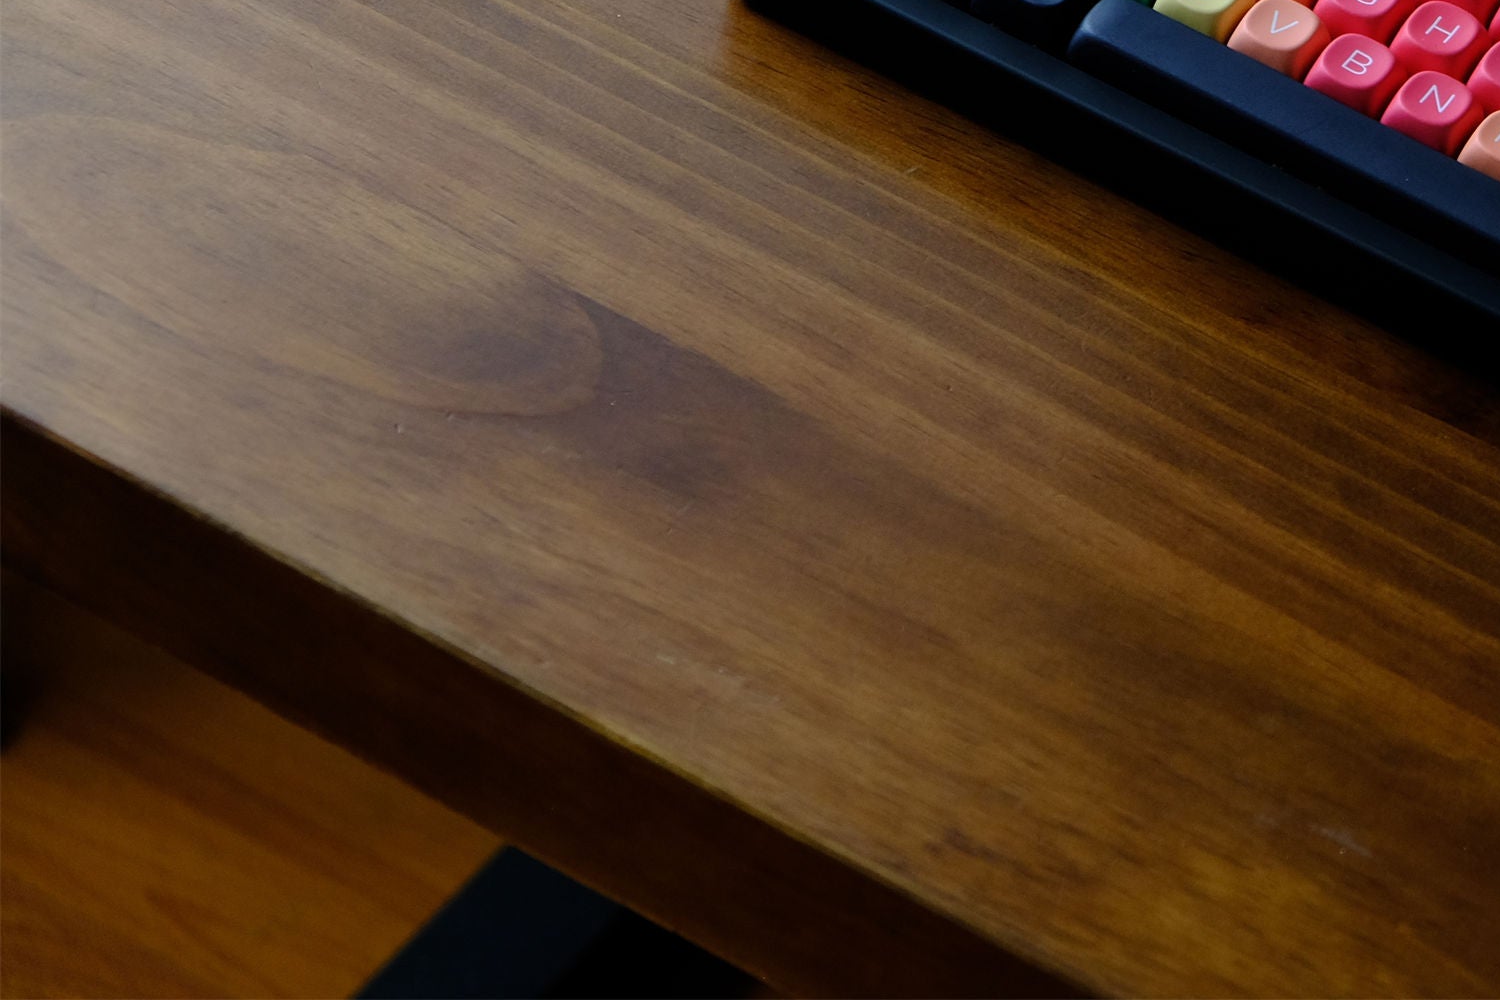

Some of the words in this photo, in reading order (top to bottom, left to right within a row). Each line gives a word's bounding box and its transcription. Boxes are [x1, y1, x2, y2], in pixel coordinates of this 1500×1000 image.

[1270, 9, 1299, 34] V
[1425, 15, 1460, 44] H
[1341, 49, 1374, 75] B
[1419, 84, 1456, 113] N
